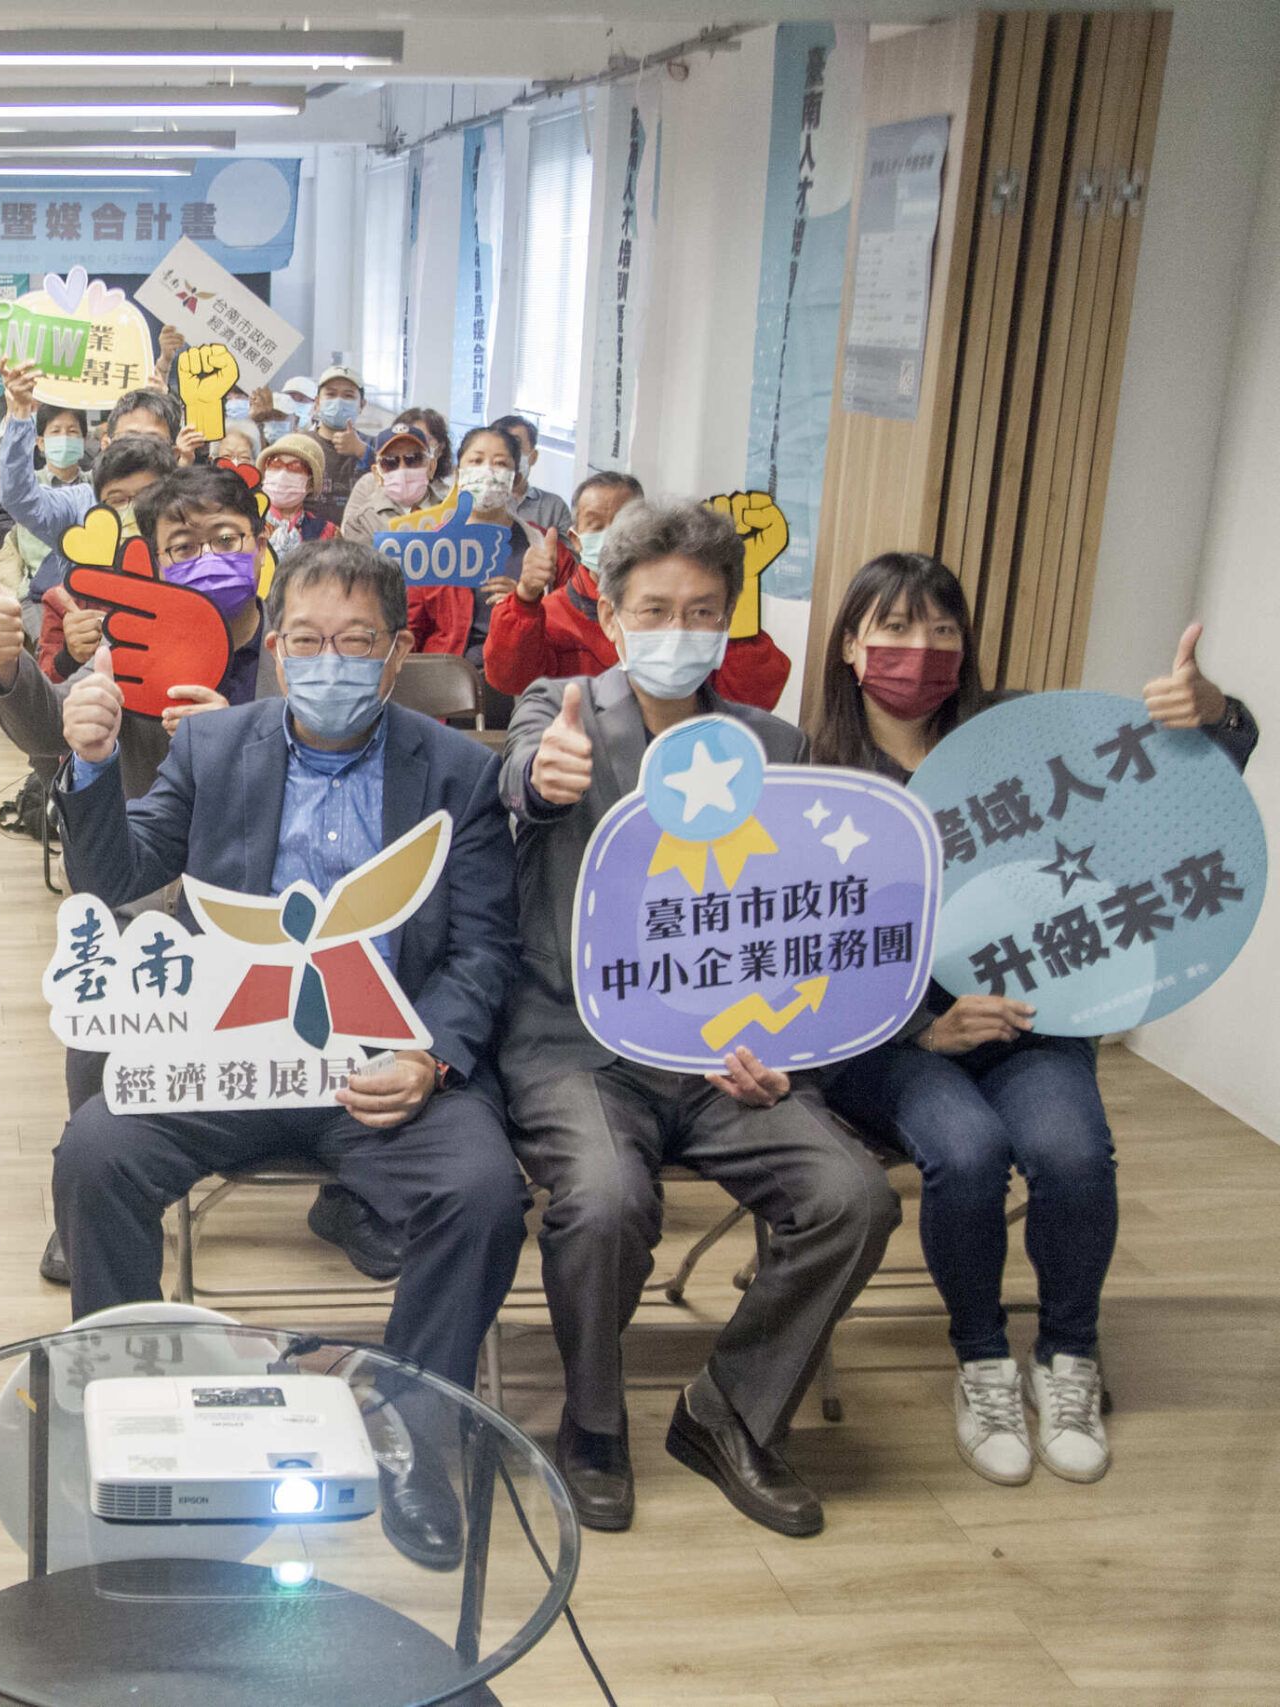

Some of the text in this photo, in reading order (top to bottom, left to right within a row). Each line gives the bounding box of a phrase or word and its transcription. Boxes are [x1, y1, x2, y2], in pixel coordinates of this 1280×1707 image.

[206, 315, 274, 375] 經濟發展局
[212, 298, 278, 355] 台南市政府
[42, 358, 140, 389] 幫手
[645, 875, 869, 941] 臺南市政府
[969, 850, 1245, 997] 升級未來
[53, 907, 195, 1003] 臺南
[602, 921, 914, 1001] 中小企業服務團
[64, 1010, 189, 1037] TAINAN
[115, 1057, 361, 1105] 經濟發展局
